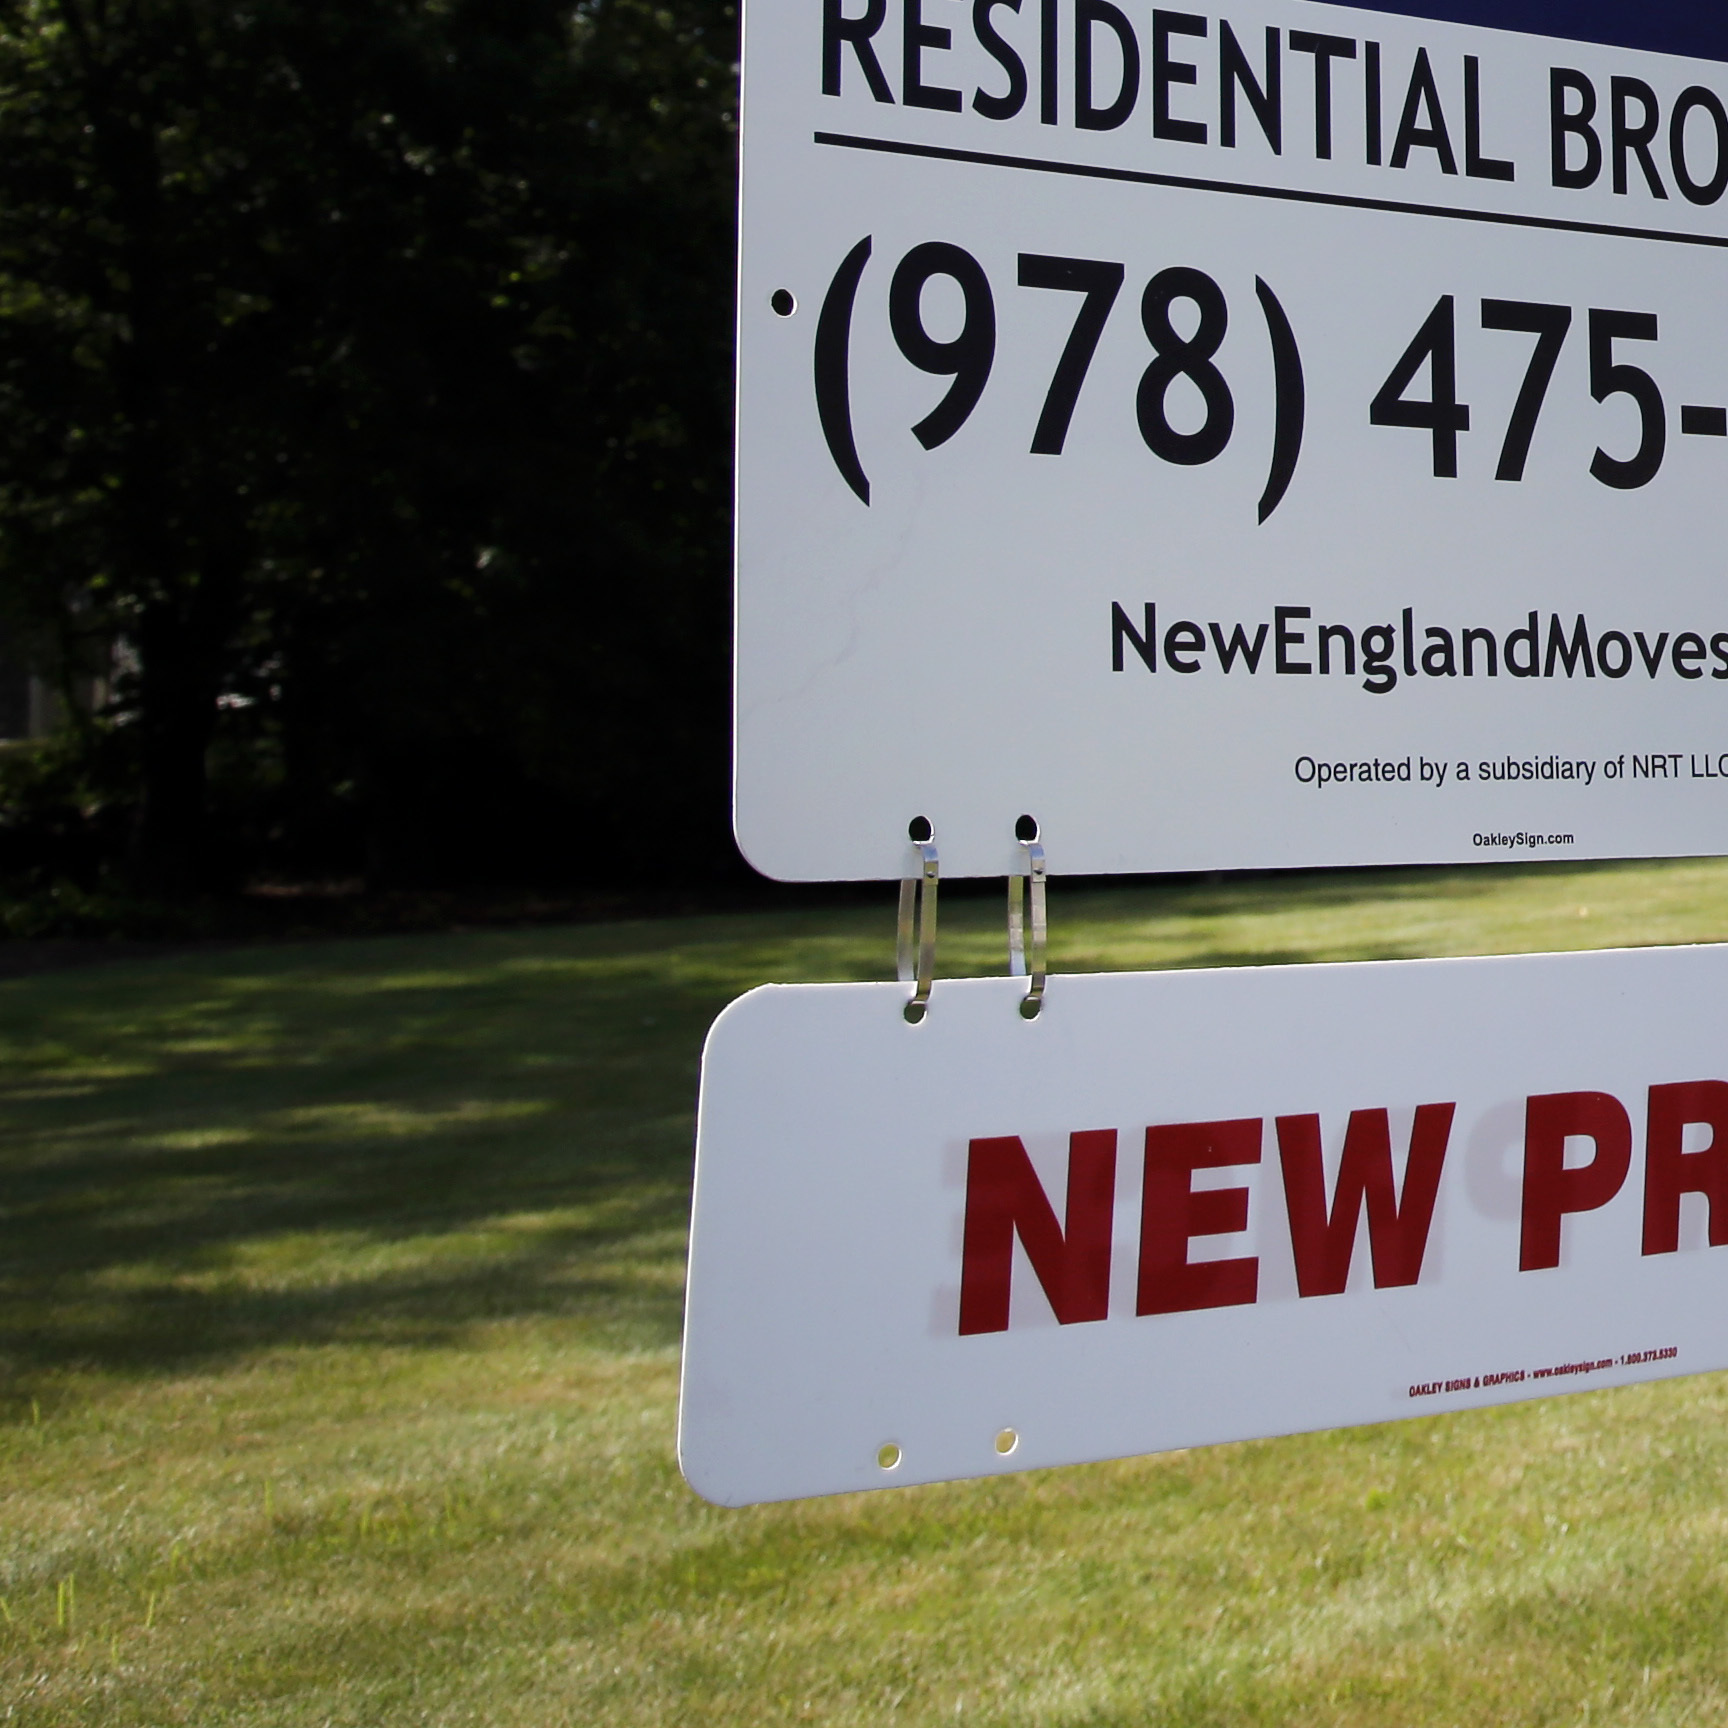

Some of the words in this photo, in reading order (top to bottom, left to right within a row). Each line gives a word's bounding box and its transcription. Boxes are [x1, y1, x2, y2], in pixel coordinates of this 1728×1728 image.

[813, 234, 1305, 526] (978)
[1294, 756, 1411, 789] Operated
[1419, 756, 1448, 788] by
[1456, 761, 1471, 781] a
[1478, 755, 1597, 786] subsidiary
[1603, 754, 1625, 779] of
[1632, 754, 1684, 779] NRT
[1472, 831, 1575, 850] OakleySign.com
[961, 1102, 1455, 1334] NEW
[1408, 1381, 1443, 1398] OAKLEY
[1445, 1377, 1472, 1393] SIGNS
[1483, 1370, 1526, 1387] GRAPHICS
